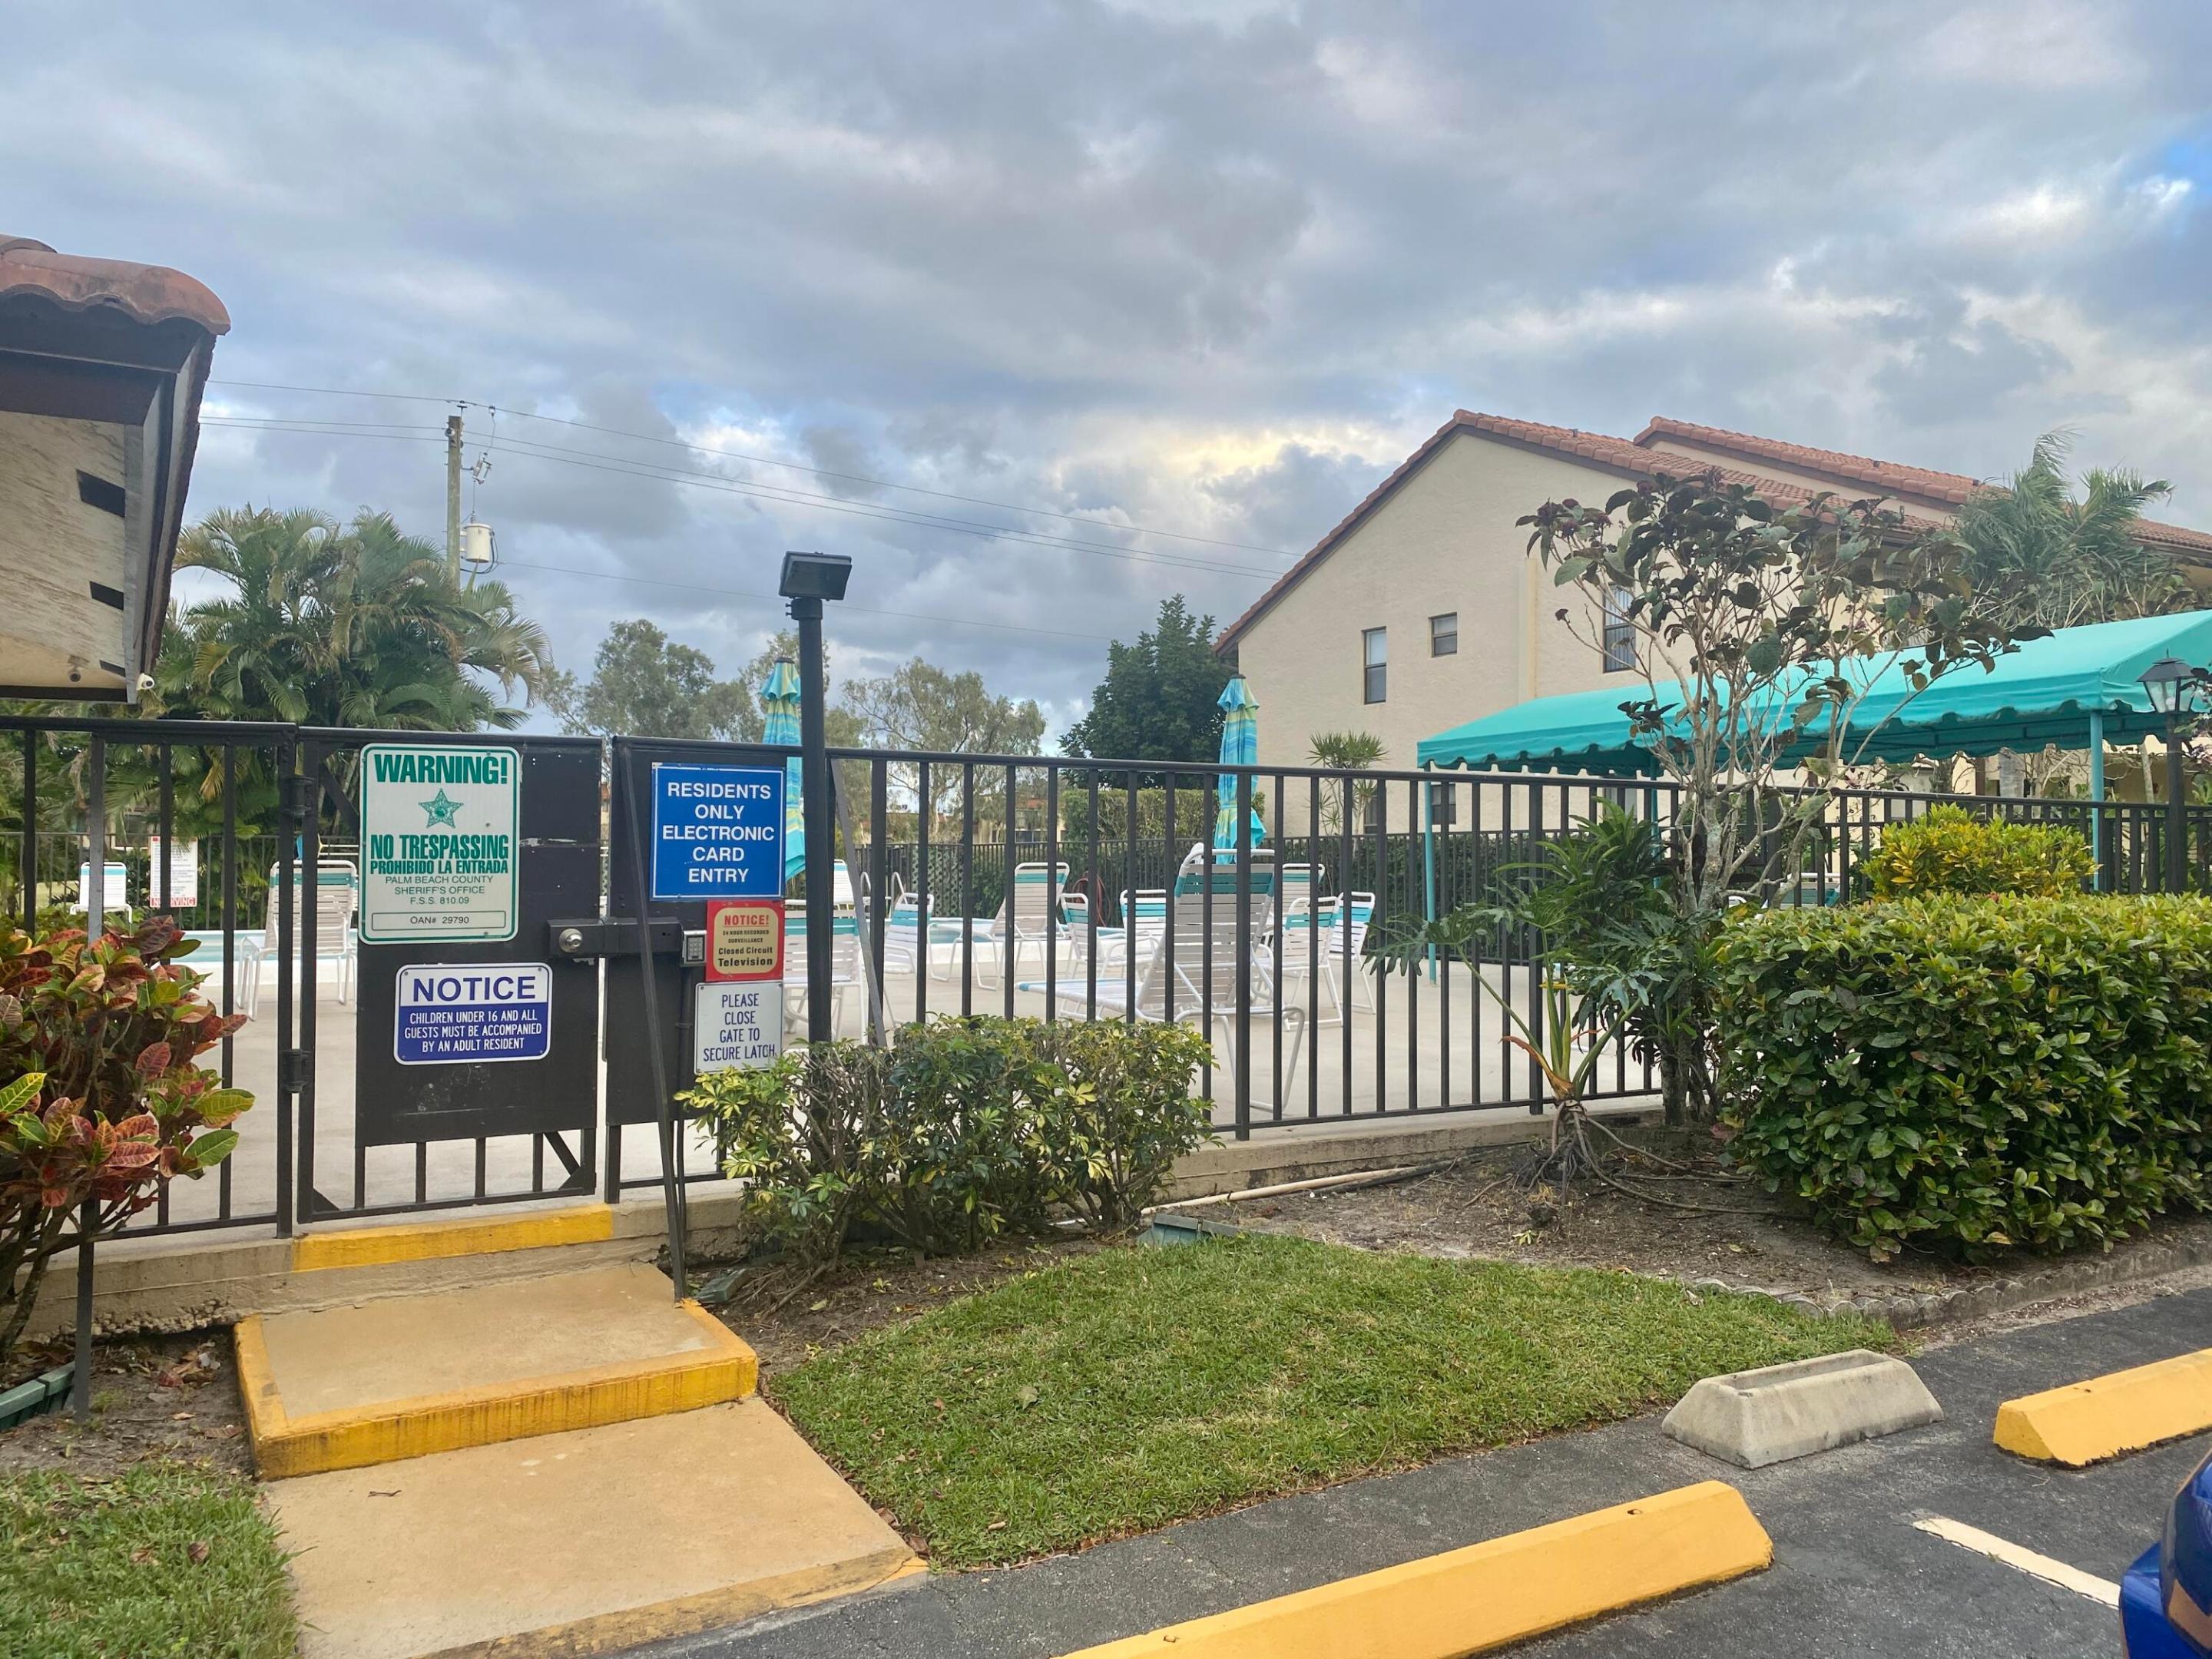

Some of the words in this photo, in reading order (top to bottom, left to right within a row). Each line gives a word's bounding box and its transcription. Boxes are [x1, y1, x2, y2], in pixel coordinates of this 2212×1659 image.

[374, 754, 508, 784] WARNING!
[667, 782, 771, 800] RESIDENTS
[694, 804, 744, 820] ONLY
[663, 825, 774, 840] ELECTRONIC
[370, 835, 394, 859] NO
[399, 835, 508, 859] TRESPASSING
[693, 847, 744, 862] CARD
[370, 860, 434, 875] PROHIBIDO
[438, 860, 452, 874] LA
[456, 859, 508, 873] ENTRADA
[688, 868, 749, 882] ENTRY
[395, 886, 446, 895] SHERIFF'S
[724, 915, 769, 925] NOTICE!
[718, 958, 773, 966] Television
[413, 976, 535, 1002] NOTICE
[722, 993, 759, 1008] PLEASE
[410, 1012, 453, 1024] CHILDREN
[456, 1011, 485, 1023] UNDER
[488, 1011, 497, 1022] 16
[501, 1010, 518, 1021] AND
[522, 1009, 538, 1020] ALL
[725, 1011, 756, 1025] CLOSE
[405, 1027, 439, 1038] GUESTS
[442, 1026, 465, 1038] MUST
[468, 1025, 479, 1037] BE
[482, 1023, 541, 1036] ACCOMPANIED
[720, 1029, 743, 1043] GATE
[749, 1028, 760, 1041] TO
[422, 1041, 434, 1052] BY
[438, 1041, 450, 1051] AN
[453, 1039, 481, 1051] ADULT
[484, 1038, 525, 1050] RESIDENT
[704, 1047, 740, 1061] SECURE
